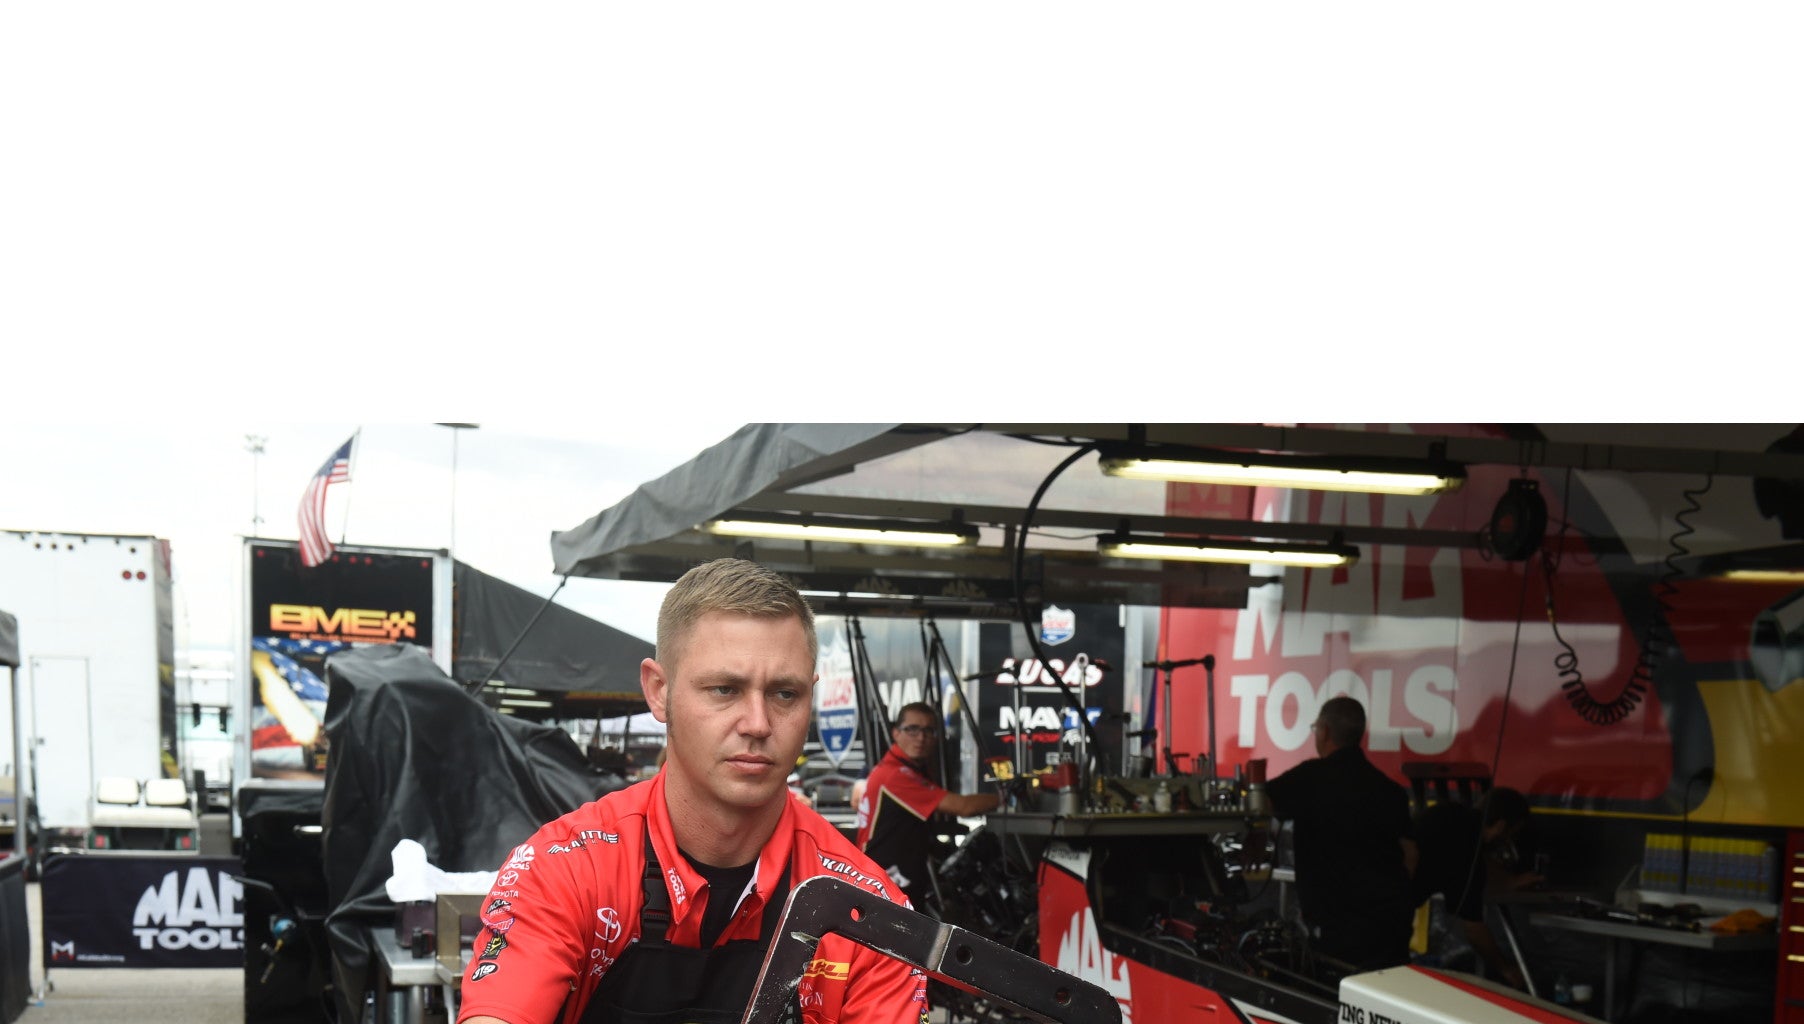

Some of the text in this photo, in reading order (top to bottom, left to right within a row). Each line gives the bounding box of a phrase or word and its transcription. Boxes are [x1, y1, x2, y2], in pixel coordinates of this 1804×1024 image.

[270, 603, 388, 636] BME
[996, 657, 1105, 687] LUCAS
[822, 858, 882, 891] KALITTA
[133, 928, 245, 950] TOOL
